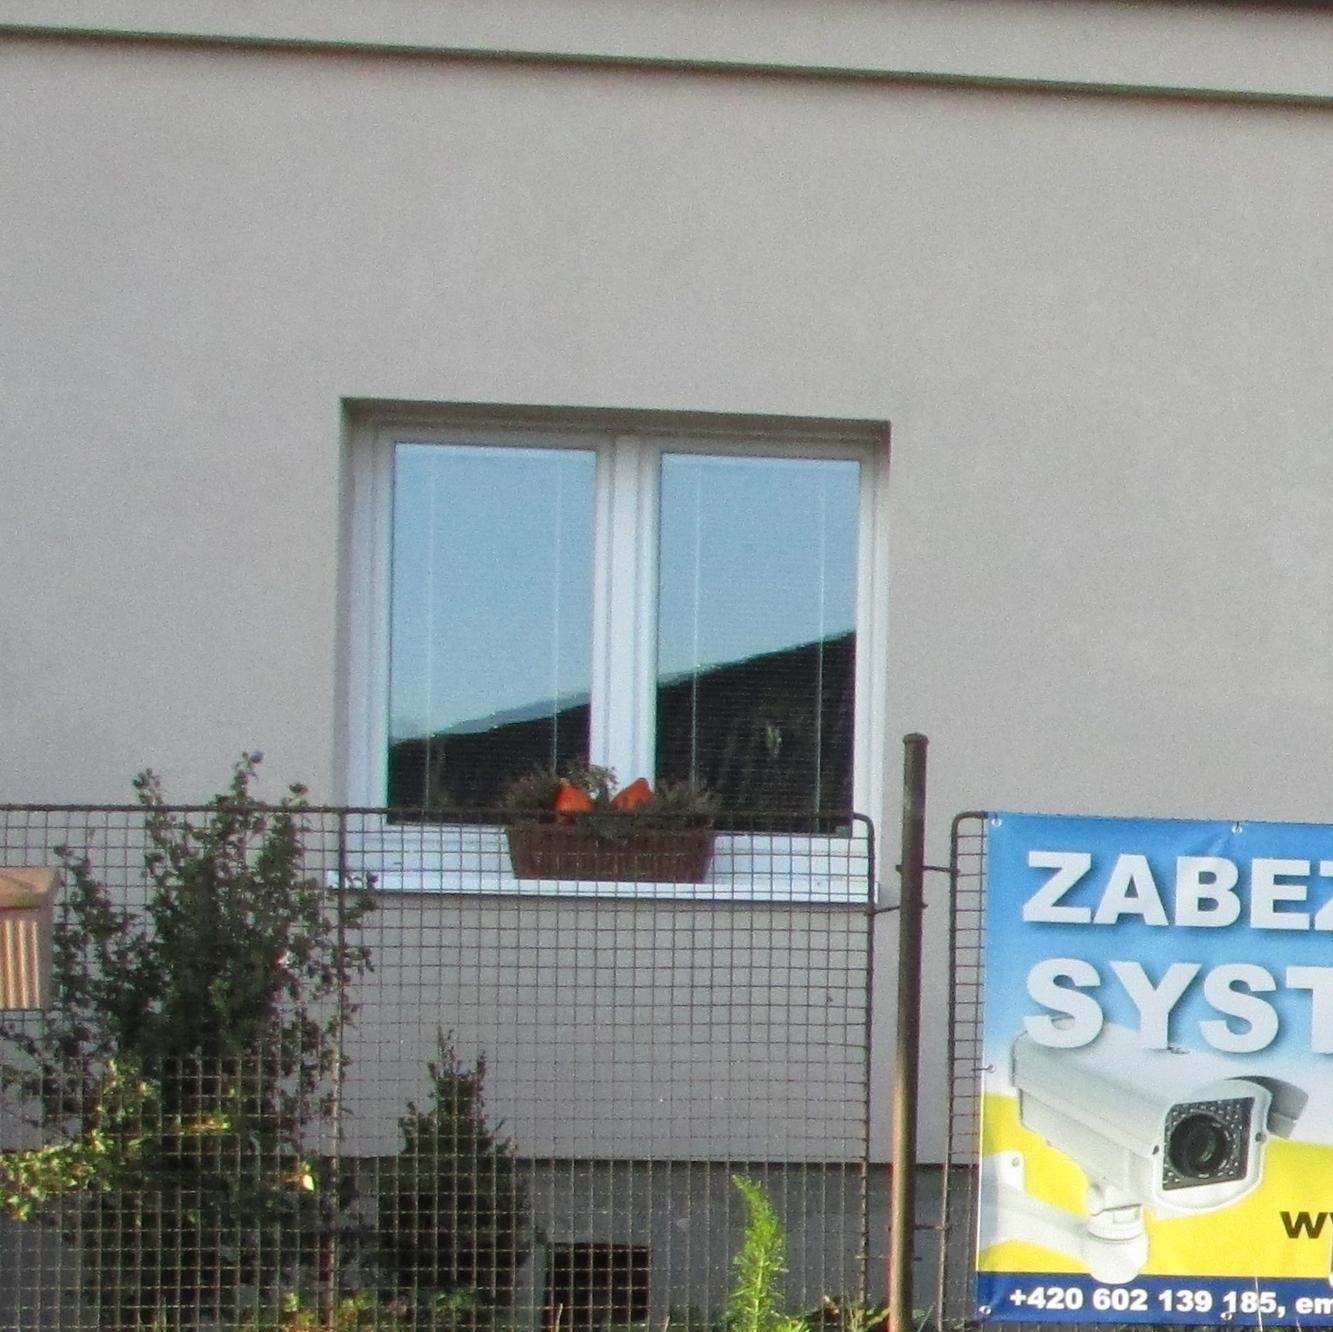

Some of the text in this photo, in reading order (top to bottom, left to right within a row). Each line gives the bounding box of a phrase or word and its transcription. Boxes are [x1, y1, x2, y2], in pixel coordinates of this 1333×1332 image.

[1009, 1285, 1083, 1310] +420
[1093, 1287, 1148, 1312] 602
[1159, 1289, 1213, 1314] 139
[1223, 1291, 1286, 1319] 185,
